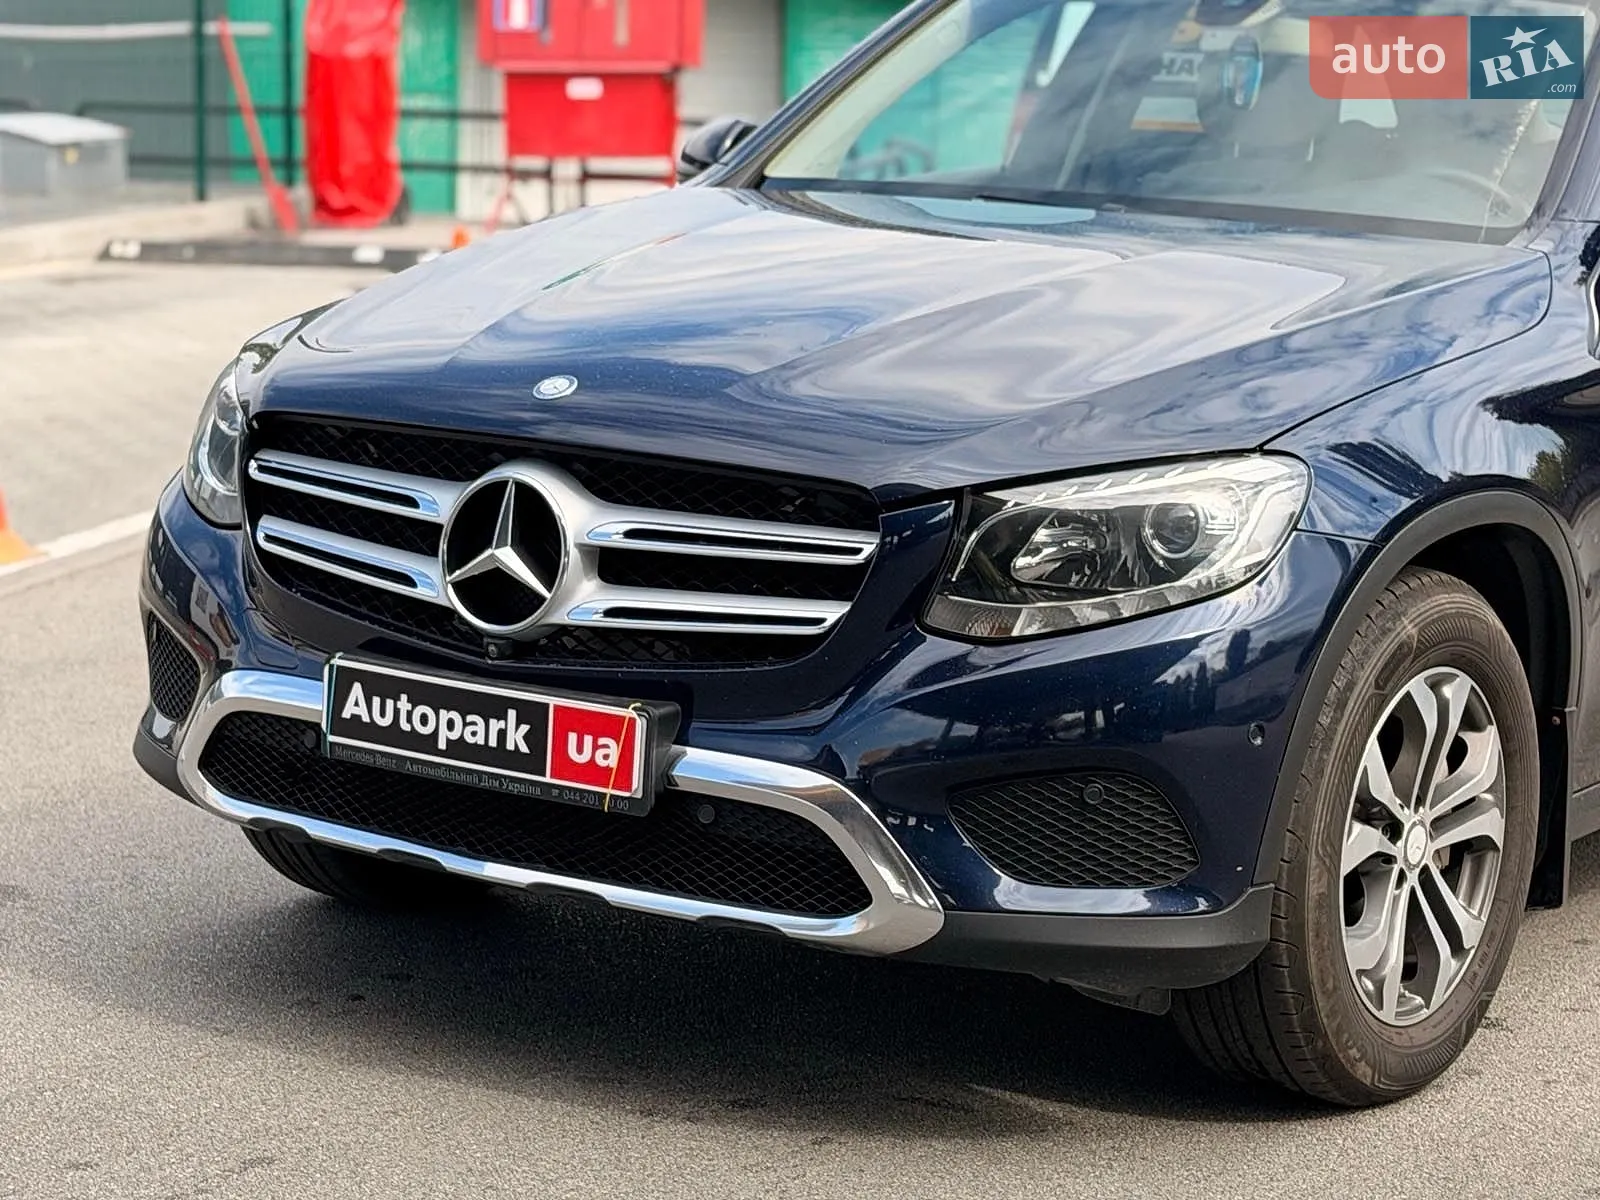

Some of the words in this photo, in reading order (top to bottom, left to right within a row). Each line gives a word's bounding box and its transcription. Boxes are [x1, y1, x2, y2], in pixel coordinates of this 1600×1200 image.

[341, 681, 531, 754] Autopark
[567, 731, 619, 768] ua
[404, 760, 479, 785] Автомобільний
[480, 774, 499, 789] Дім
[501, 777, 541, 795] Україна
